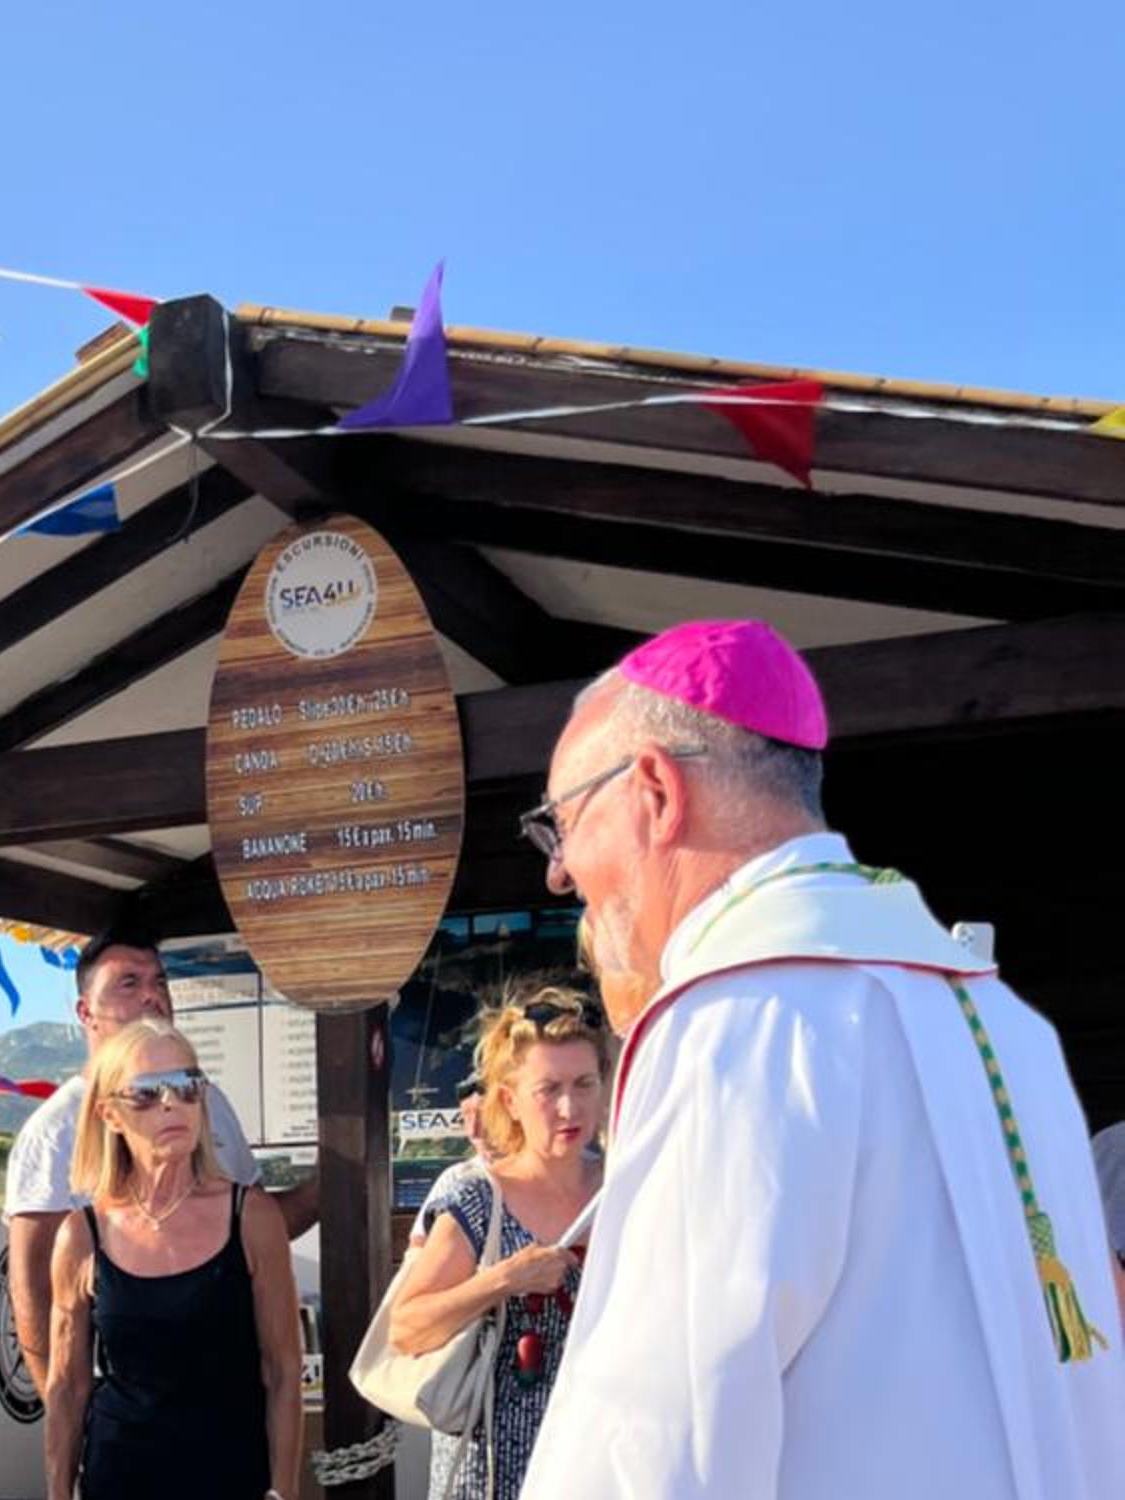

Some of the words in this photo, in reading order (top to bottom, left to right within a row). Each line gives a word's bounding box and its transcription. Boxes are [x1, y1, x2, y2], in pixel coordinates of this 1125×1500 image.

[276, 535, 365, 573] ESCURSIONI
[232, 704, 282, 731] PEDALO
[235, 749, 277, 775] CANOA
[239, 795, 262, 817] SUP
[242, 831, 307, 860] BANANONE
